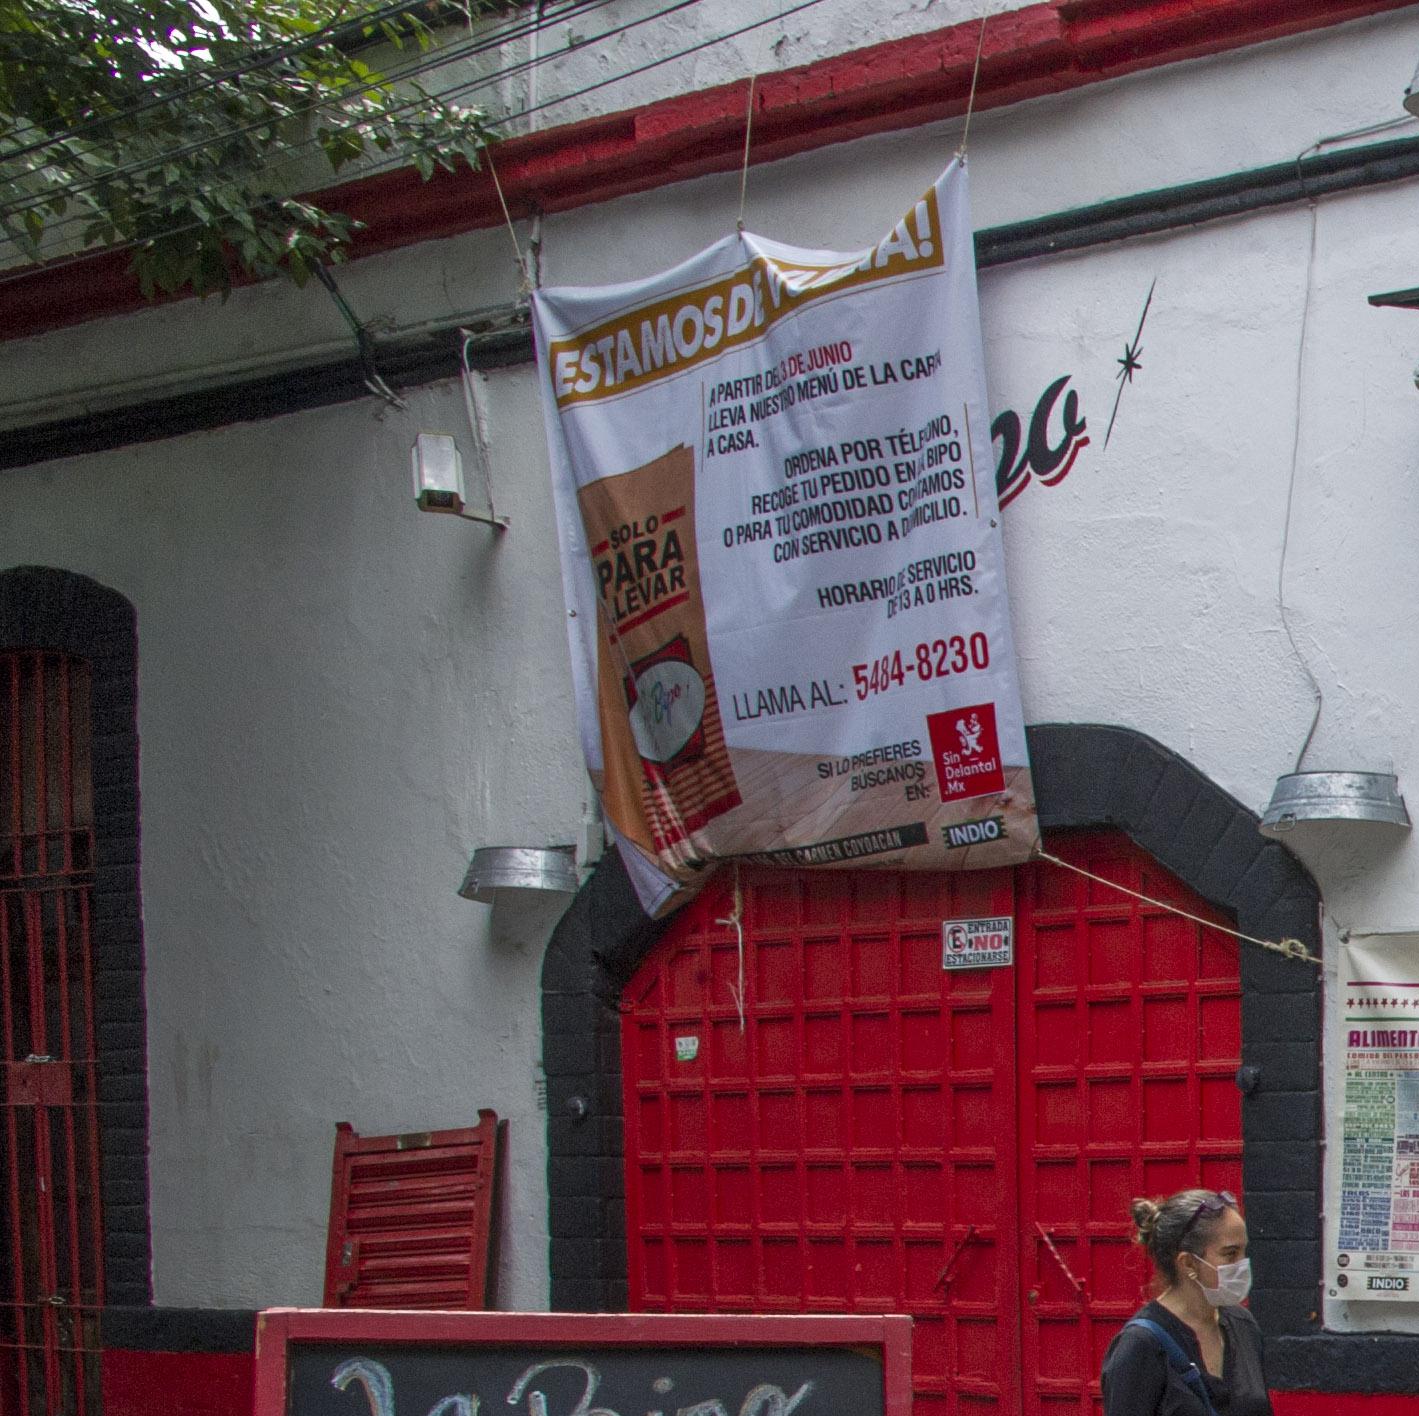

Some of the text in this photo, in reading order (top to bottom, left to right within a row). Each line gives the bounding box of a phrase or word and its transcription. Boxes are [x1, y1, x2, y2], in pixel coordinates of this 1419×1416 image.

[554, 303, 725, 398] ESTAMOS
[708, 340, 853, 407] A PARTIR DEL DE JUNIO
[707, 401, 747, 432] LLEVA
[749, 390, 796, 423] NUESTRO
[796, 366, 838, 404] MENÚ
[842, 366, 868, 392] DE
[871, 361, 898, 386] LA
[707, 429, 760, 459] A CASA.
[784, 435, 885, 480] ORDENA POR
[751, 440, 963, 516] RECOGE TU PEDIDO EN BIPO
[723, 467, 966, 549] O PARA TU COMODIDAD CONTAMOS
[610, 514, 659, 551] SOLO
[773, 495, 968, 564] CON SERVICIO A DOMICILIO.
[597, 528, 684, 600] PARA
[817, 549, 976, 609] HORARIO SERVICIO
[913, 574, 980, 607] A HRS.
[733, 631, 990, 721] LLAMA AL: 5484-8230
[817, 739, 923, 780] SI LO PREFIERES
[941, 750, 962, 767] Sin
[945, 759, 996, 780] Delantal
[948, 818, 1000, 847] INDIO
[967, 921, 1009, 934] ENTRADA
[973, 934, 1003, 951] NO
[946, 951, 1009, 964] ESTACIONARSE
[1372, 1278, 1405, 1290] INDIO
